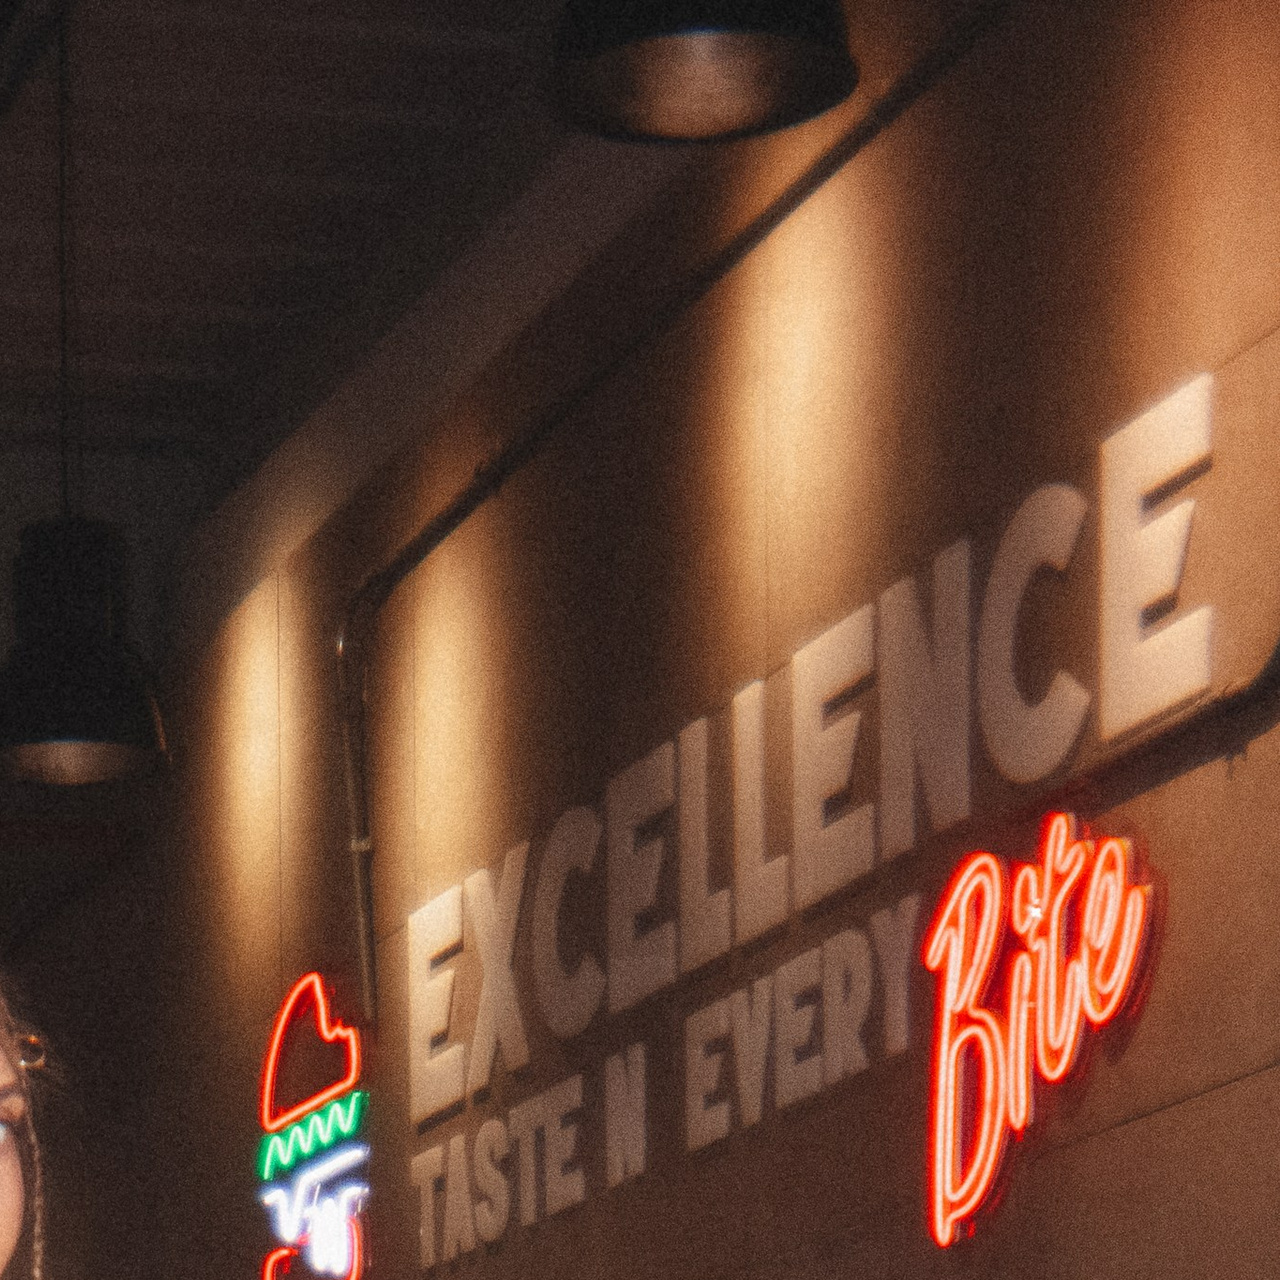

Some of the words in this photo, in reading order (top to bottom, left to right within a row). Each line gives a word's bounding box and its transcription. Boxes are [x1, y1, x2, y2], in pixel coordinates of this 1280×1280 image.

[409, 372, 1213, 1125] EXCELLENCE
[411, 1074, 586, 1270] TASTE
[685, 893, 921, 1153] EVERY
[925, 812, 1148, 1247] Bite
